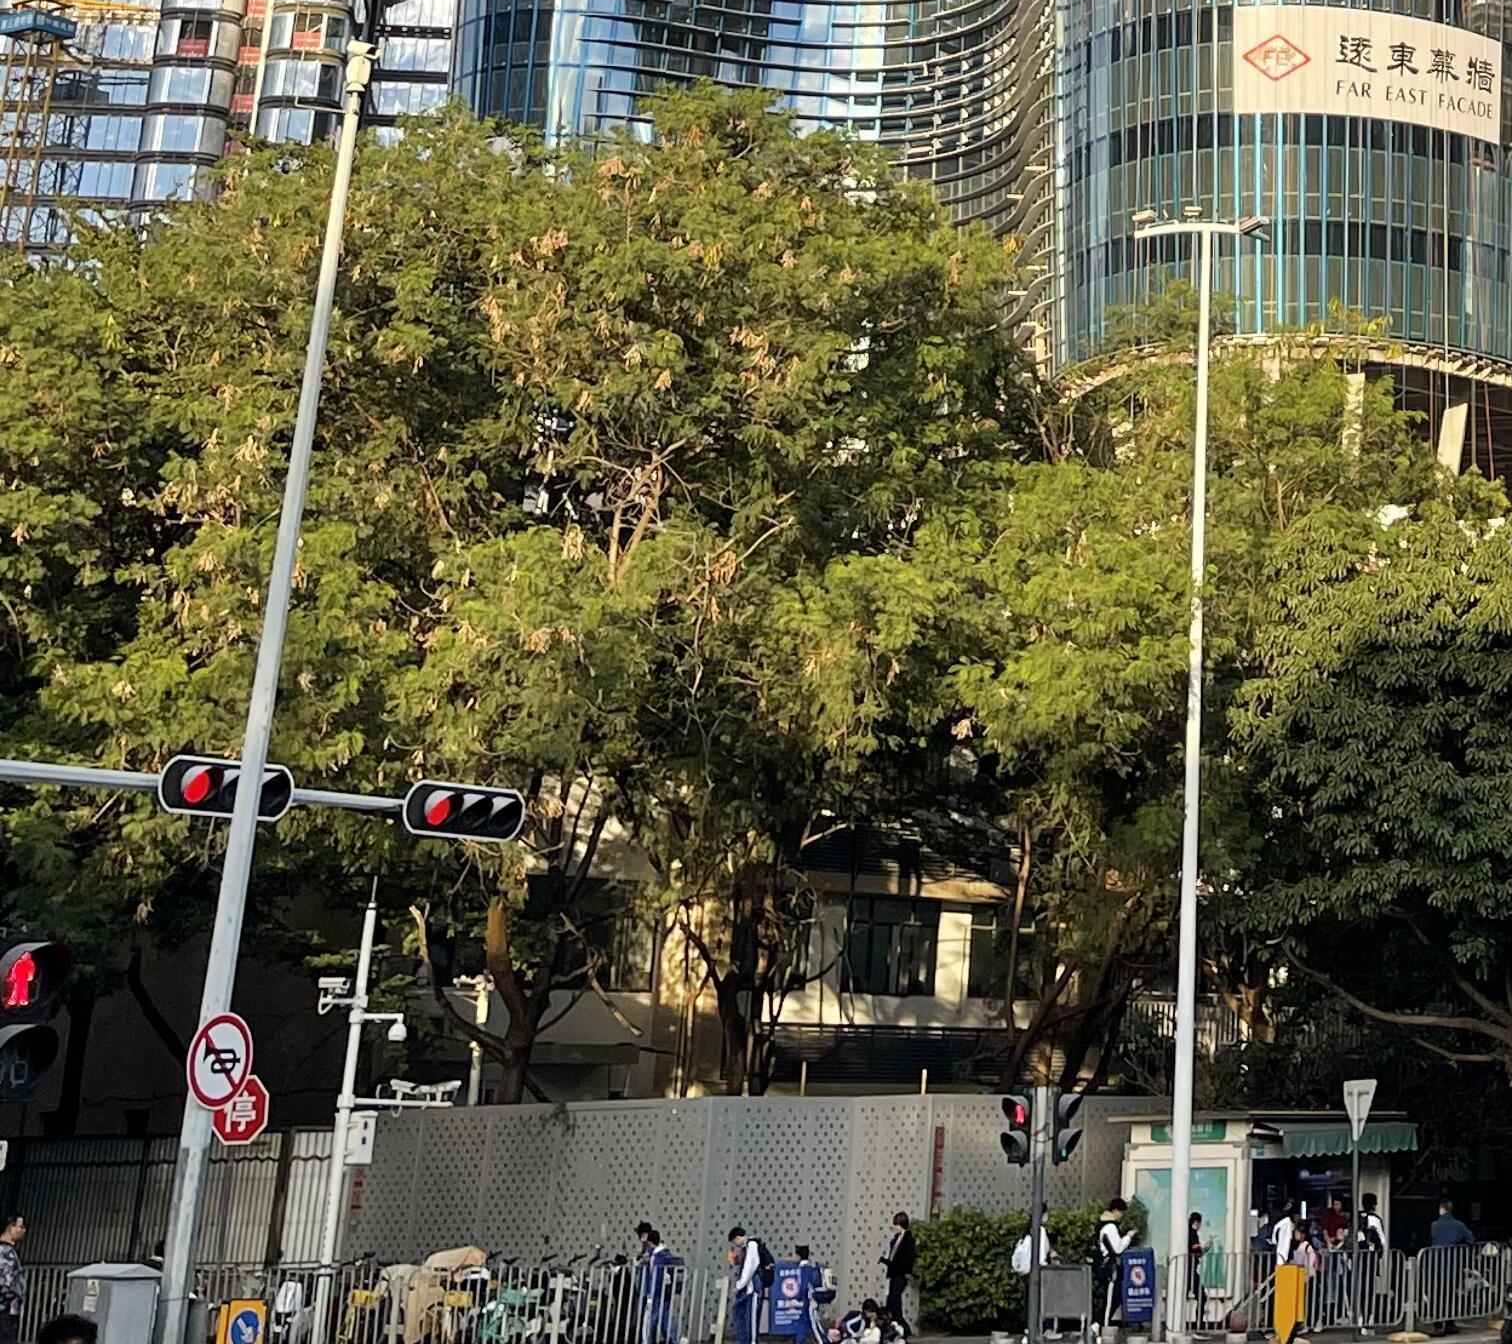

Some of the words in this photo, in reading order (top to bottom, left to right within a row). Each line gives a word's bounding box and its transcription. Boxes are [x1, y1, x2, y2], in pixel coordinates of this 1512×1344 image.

[1335, 79, 1372, 99] FAR
[1385, 88, 1428, 107] EAST
[1438, 93, 1494, 120] FACADE
[223, 1089, 256, 1133] 停
